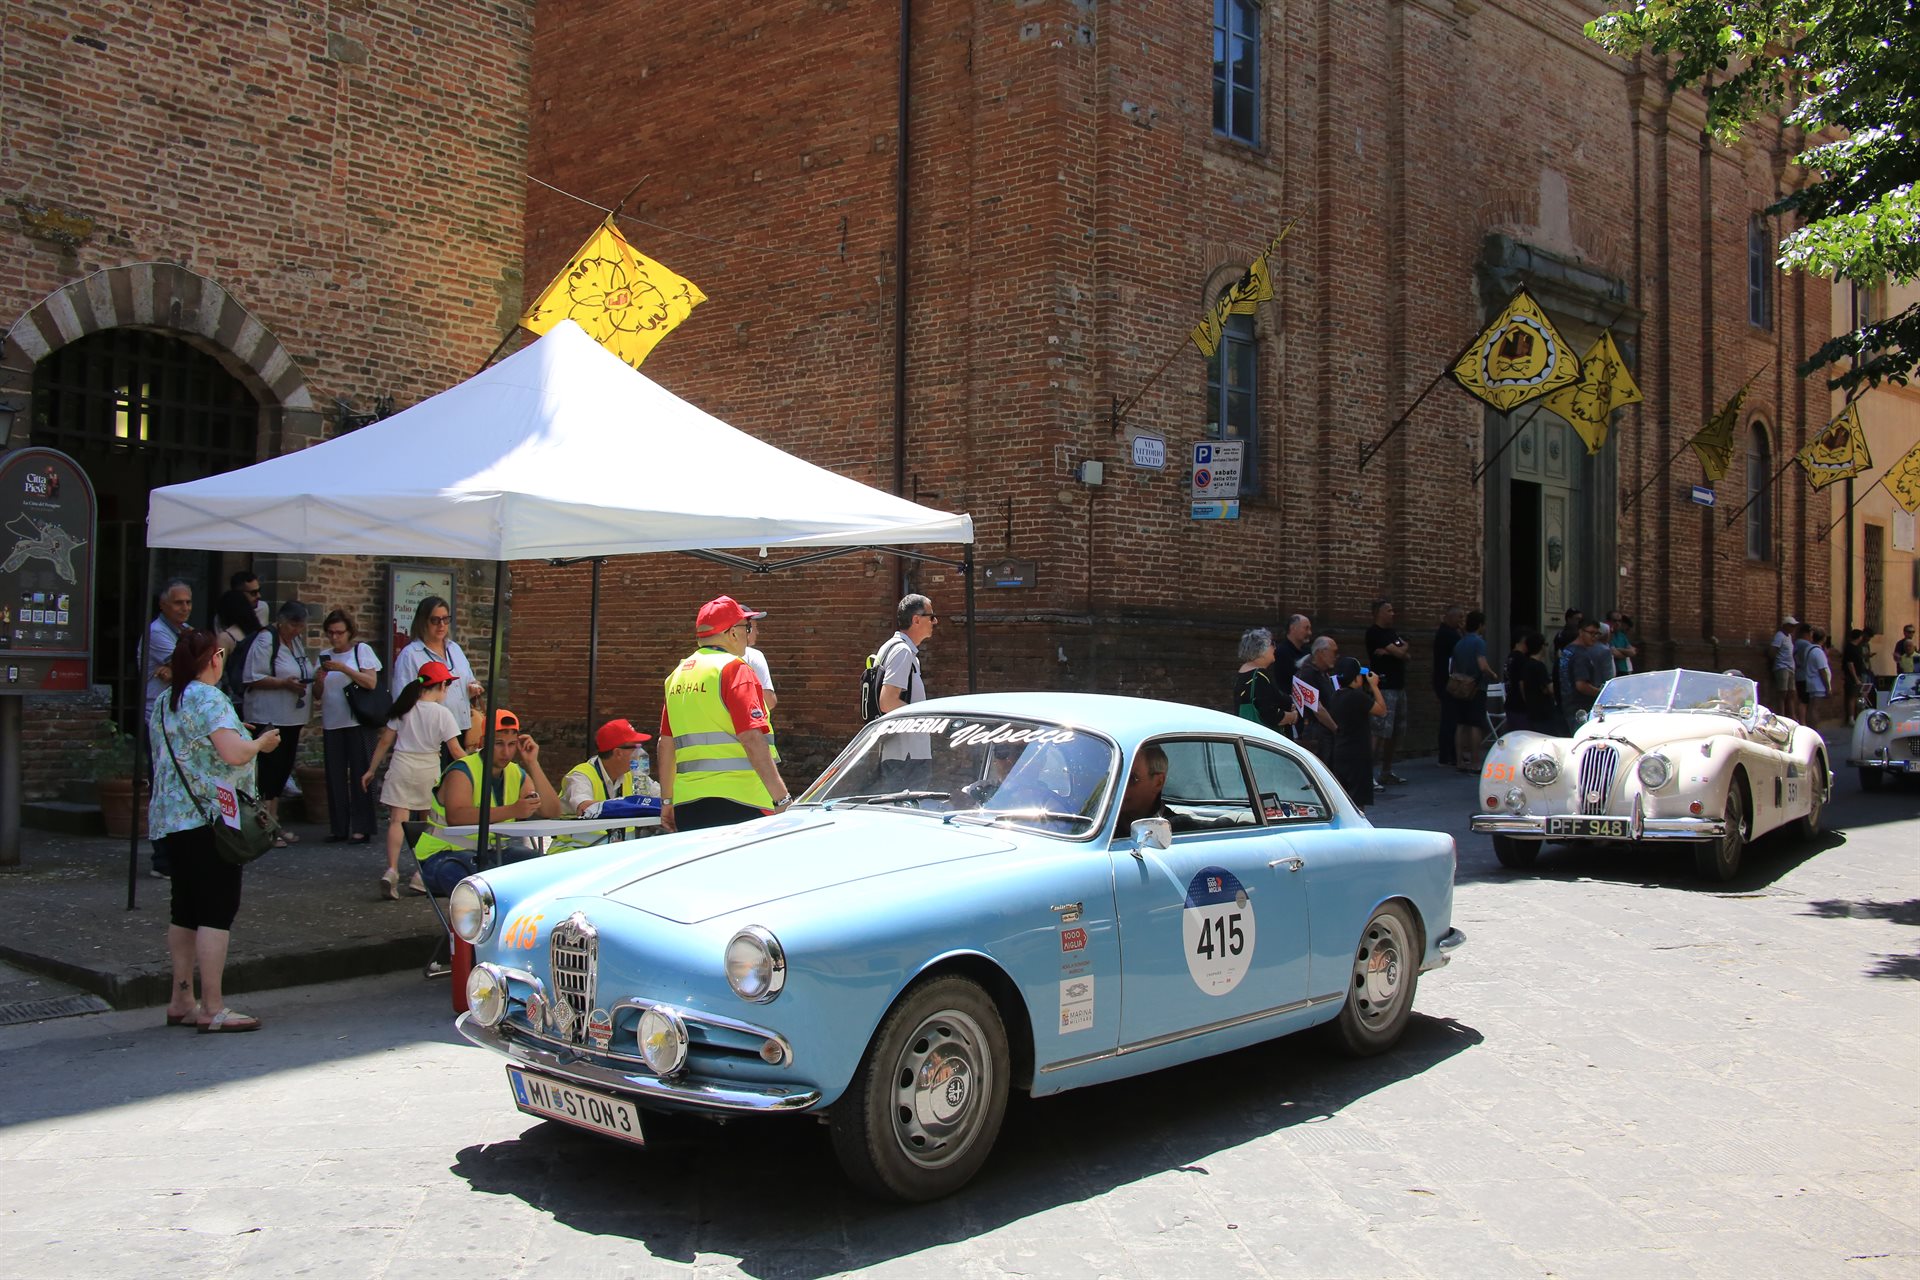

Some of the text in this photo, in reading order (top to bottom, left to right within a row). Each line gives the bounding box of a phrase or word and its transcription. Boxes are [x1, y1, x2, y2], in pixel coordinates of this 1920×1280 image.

[1135, 447, 1163, 457] VITTORIO
[1144, 441, 1154, 449] VIA
[1137, 455, 1160, 464] VENETO
[1198, 448, 1209, 462] P
[873, 717, 950, 737] SCUDERIA
[1483, 763, 1515, 781] 551
[1550, 819, 1622, 836] PFF 948
[504, 914, 545, 950] 415
[1064, 930, 1081, 940] 1000
[1197, 913, 1244, 960] 415
[1064, 940, 1083, 951] MIGLIA
[1069, 1008, 1092, 1018] MARINA
[528, 1080, 551, 1108] MI
